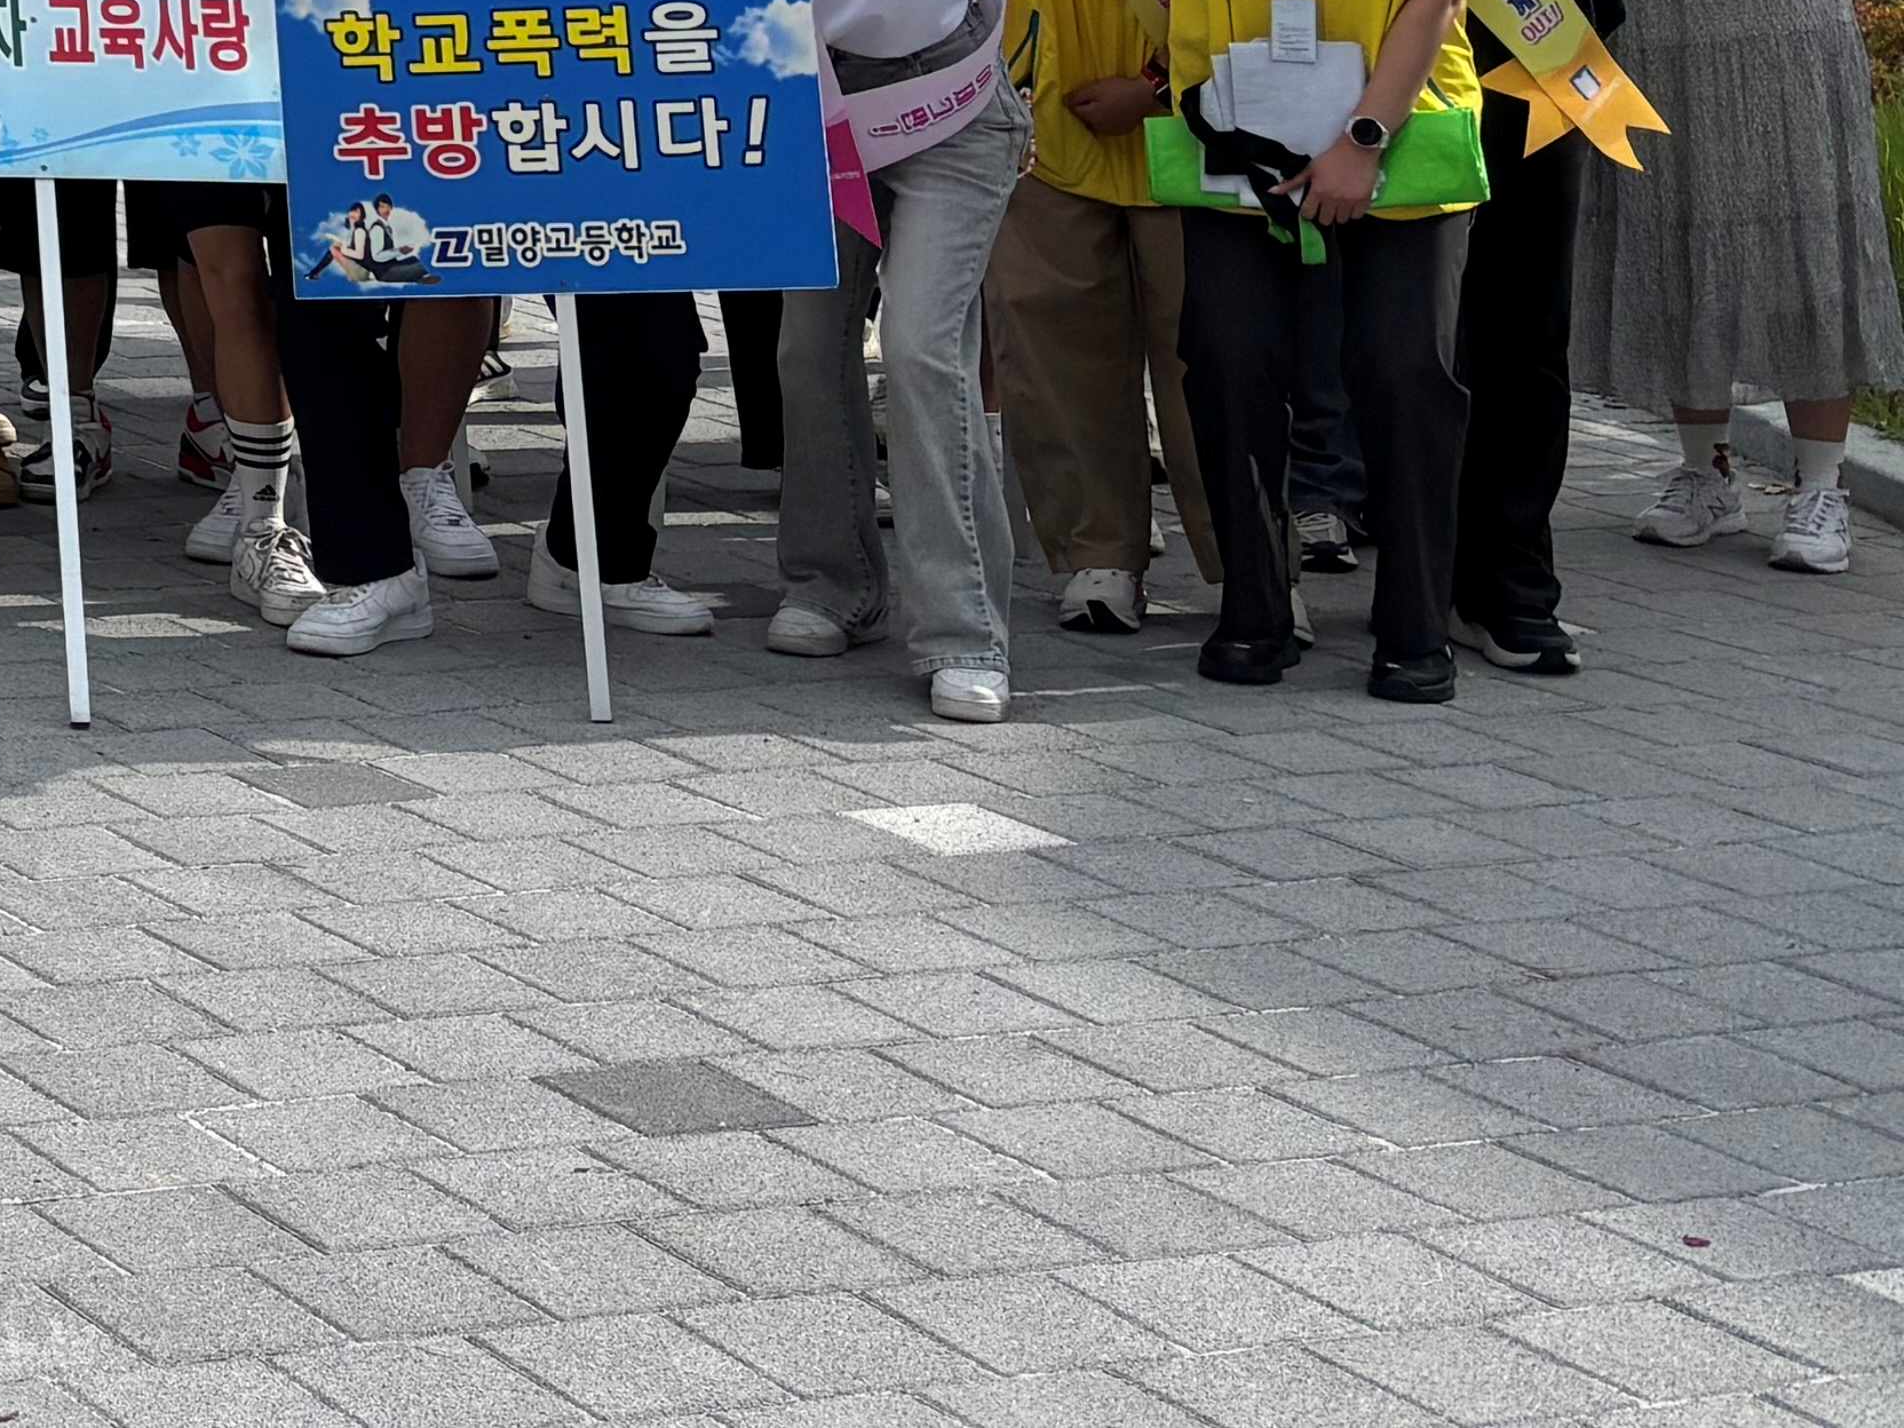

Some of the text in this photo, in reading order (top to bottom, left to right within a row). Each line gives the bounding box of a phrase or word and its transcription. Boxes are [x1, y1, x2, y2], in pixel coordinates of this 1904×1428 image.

[324, 0, 719, 81] 학교폭력을
[1520, 1, 1562, 42] OUT!
[335, 96, 769, 180] 추방합시다!
[473, 220, 688, 268] 밀양고등학교
